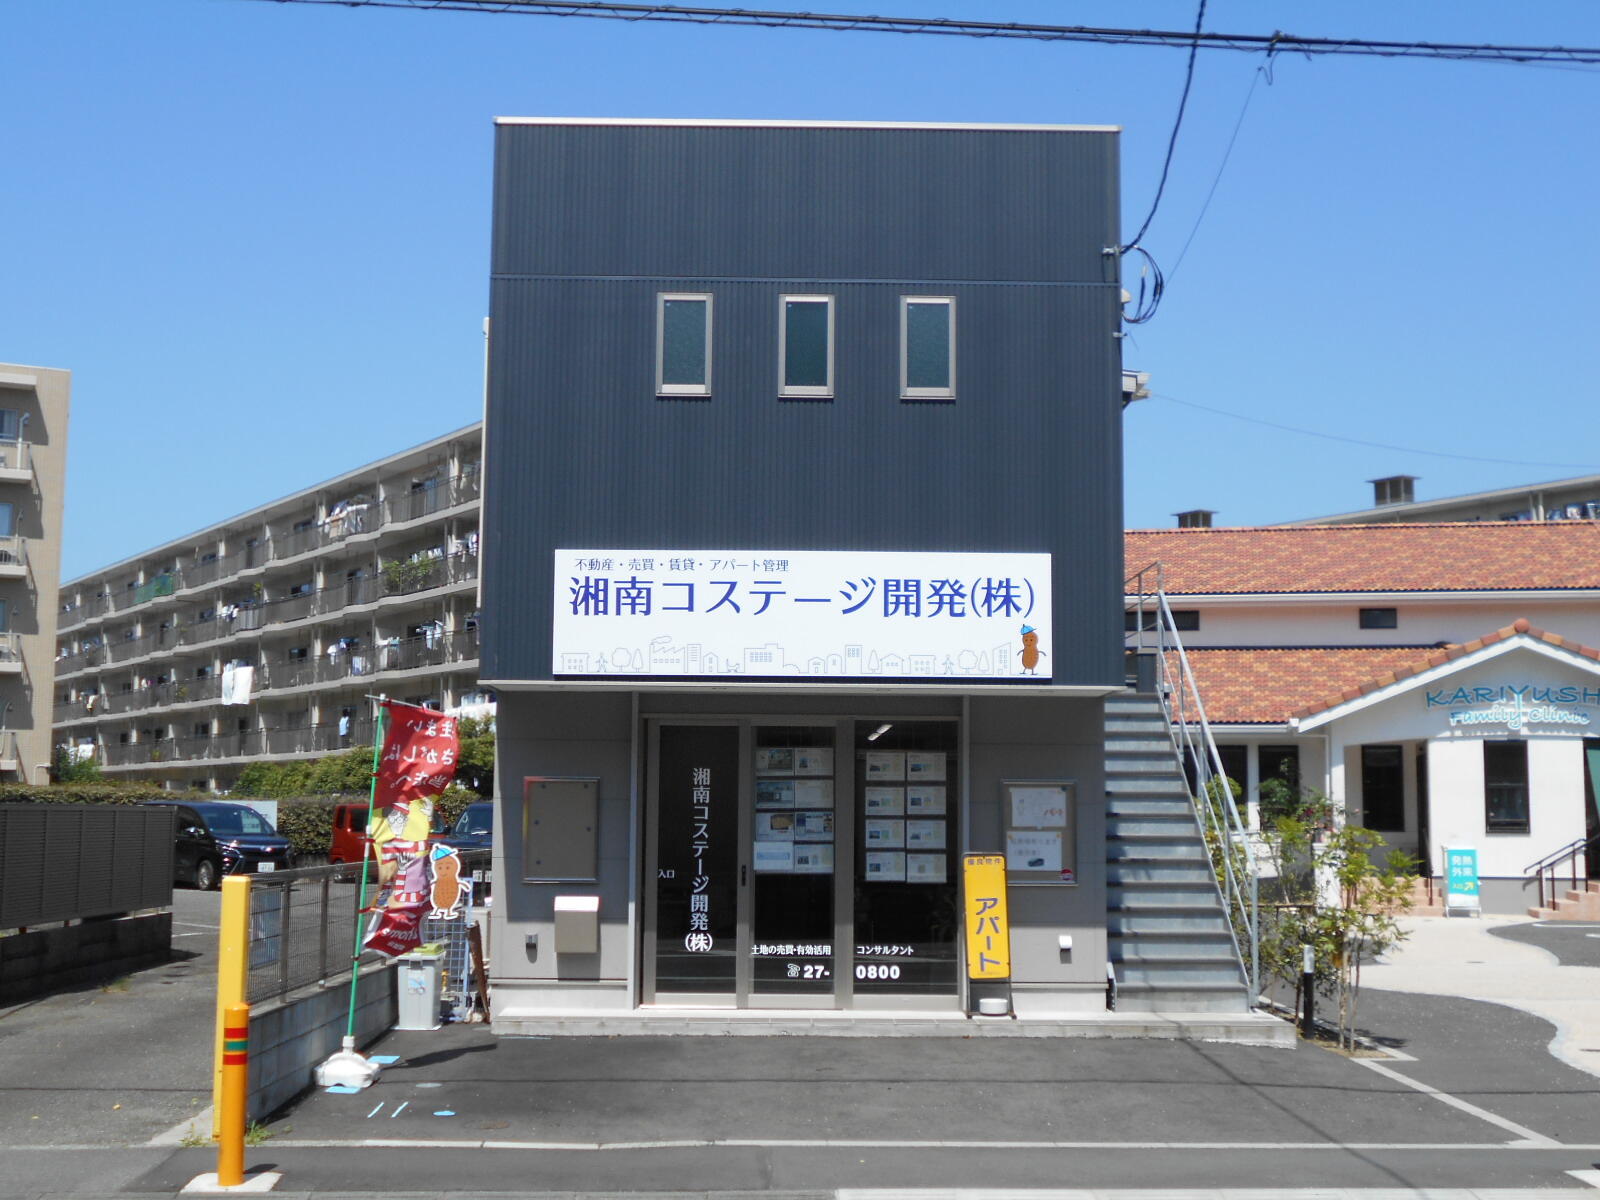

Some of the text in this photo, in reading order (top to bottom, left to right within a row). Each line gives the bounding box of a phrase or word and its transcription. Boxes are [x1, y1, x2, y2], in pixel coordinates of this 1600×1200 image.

[575, 558, 789, 572] 不動産・売買・賃貸・アパート管理
[569, 576, 1035, 617] 湘南コステージ開発(株)
[1449, 704, 1591, 729] Family Clinic
[685, 767, 713, 953] 湘南コステージ開発(株)
[658, 869, 675, 879] 入口
[975, 897, 1000, 972] アパート
[856, 945, 914, 956] コンサルタント
[856, 965, 900, 979] 0800
